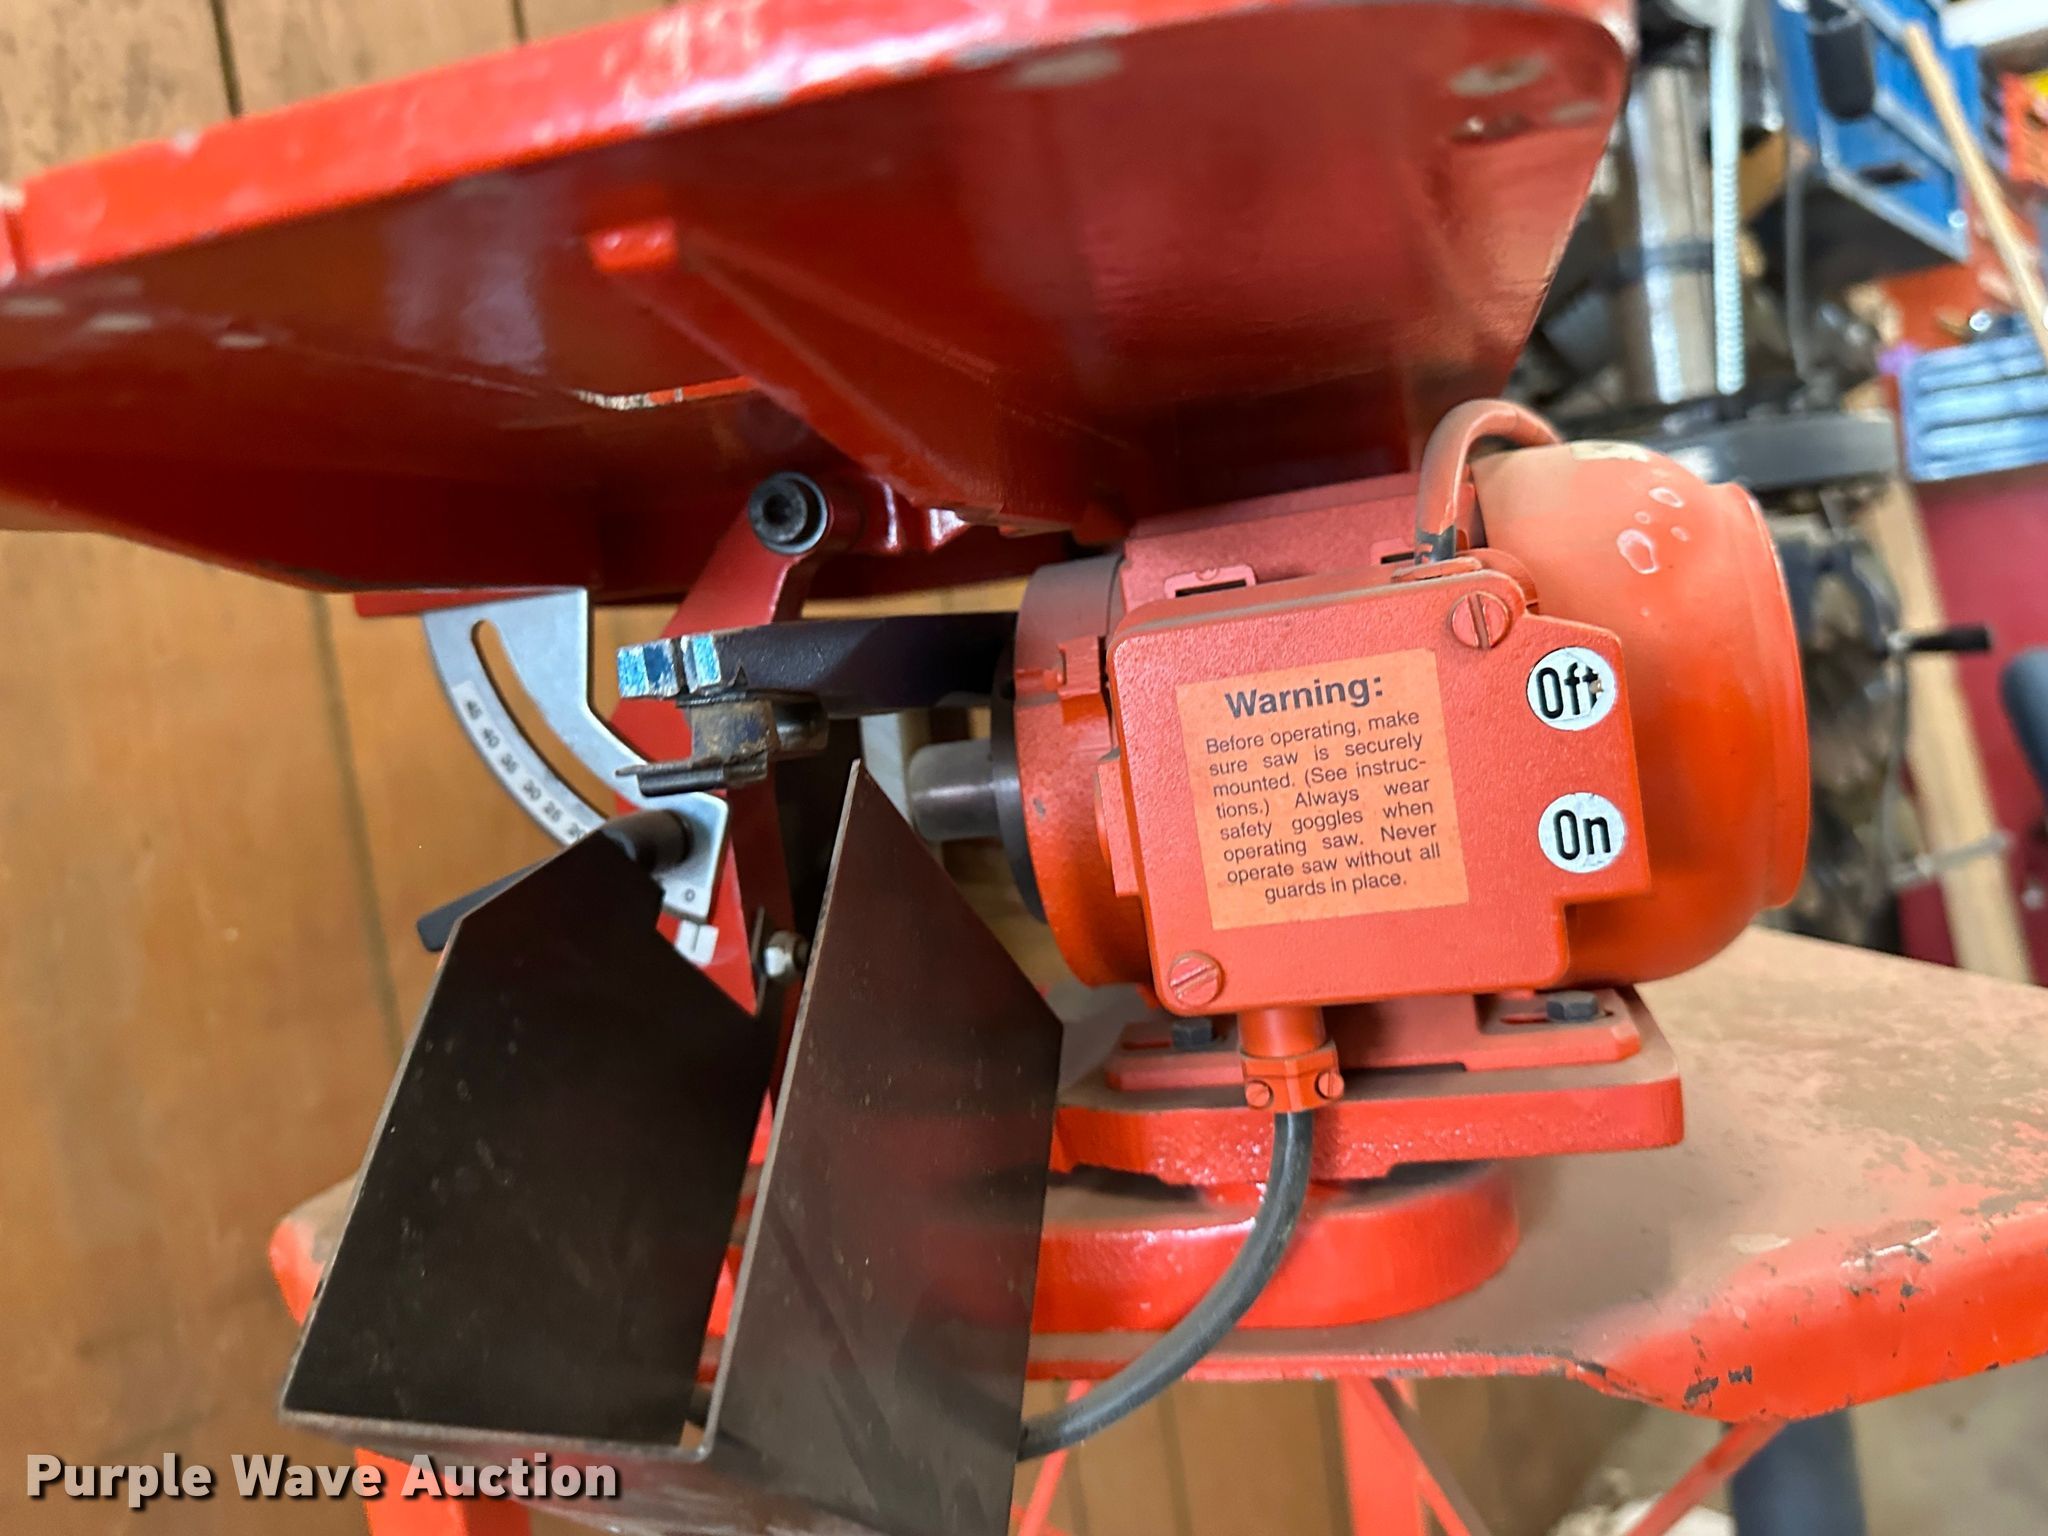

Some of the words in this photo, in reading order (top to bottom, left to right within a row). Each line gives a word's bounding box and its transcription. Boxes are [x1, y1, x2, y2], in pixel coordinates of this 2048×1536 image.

[1224, 676, 1383, 719] Warning:
[1206, 733, 1264, 755] Before
[1270, 719, 1362, 747] operating,
[1368, 709, 1420, 731] make
[1209, 758, 1248, 777] sure
[1263, 752, 1298, 768] saw
[1314, 745, 1329, 761] is
[1345, 732, 1423, 757] securely
[1213, 773, 1295, 798] mounted.
[1304, 767, 1348, 789] (See
[1355, 758, 1427, 779] instruc-
[1216, 799, 1270, 820] tions.)
[1294, 786, 1360, 809] Always
[1384, 777, 1430, 796] wear
[1220, 820, 1272, 841] safety
[1291, 808, 1363, 835] goggles
[1383, 799, 1434, 818] when
[1553, 809, 1611, 860] On
[1223, 838, 1307, 865] operating
[1322, 834, 1364, 850] saw.
[1380, 822, 1437, 843] Never
[1227, 861, 1295, 885] operate
[1301, 858, 1337, 873] saw
[1345, 847, 1412, 868] without
[1419, 842, 1441, 861] all
[1264, 878, 1327, 905] guards
[1331, 876, 1347, 893] in
[1352, 869, 1407, 895] place.
